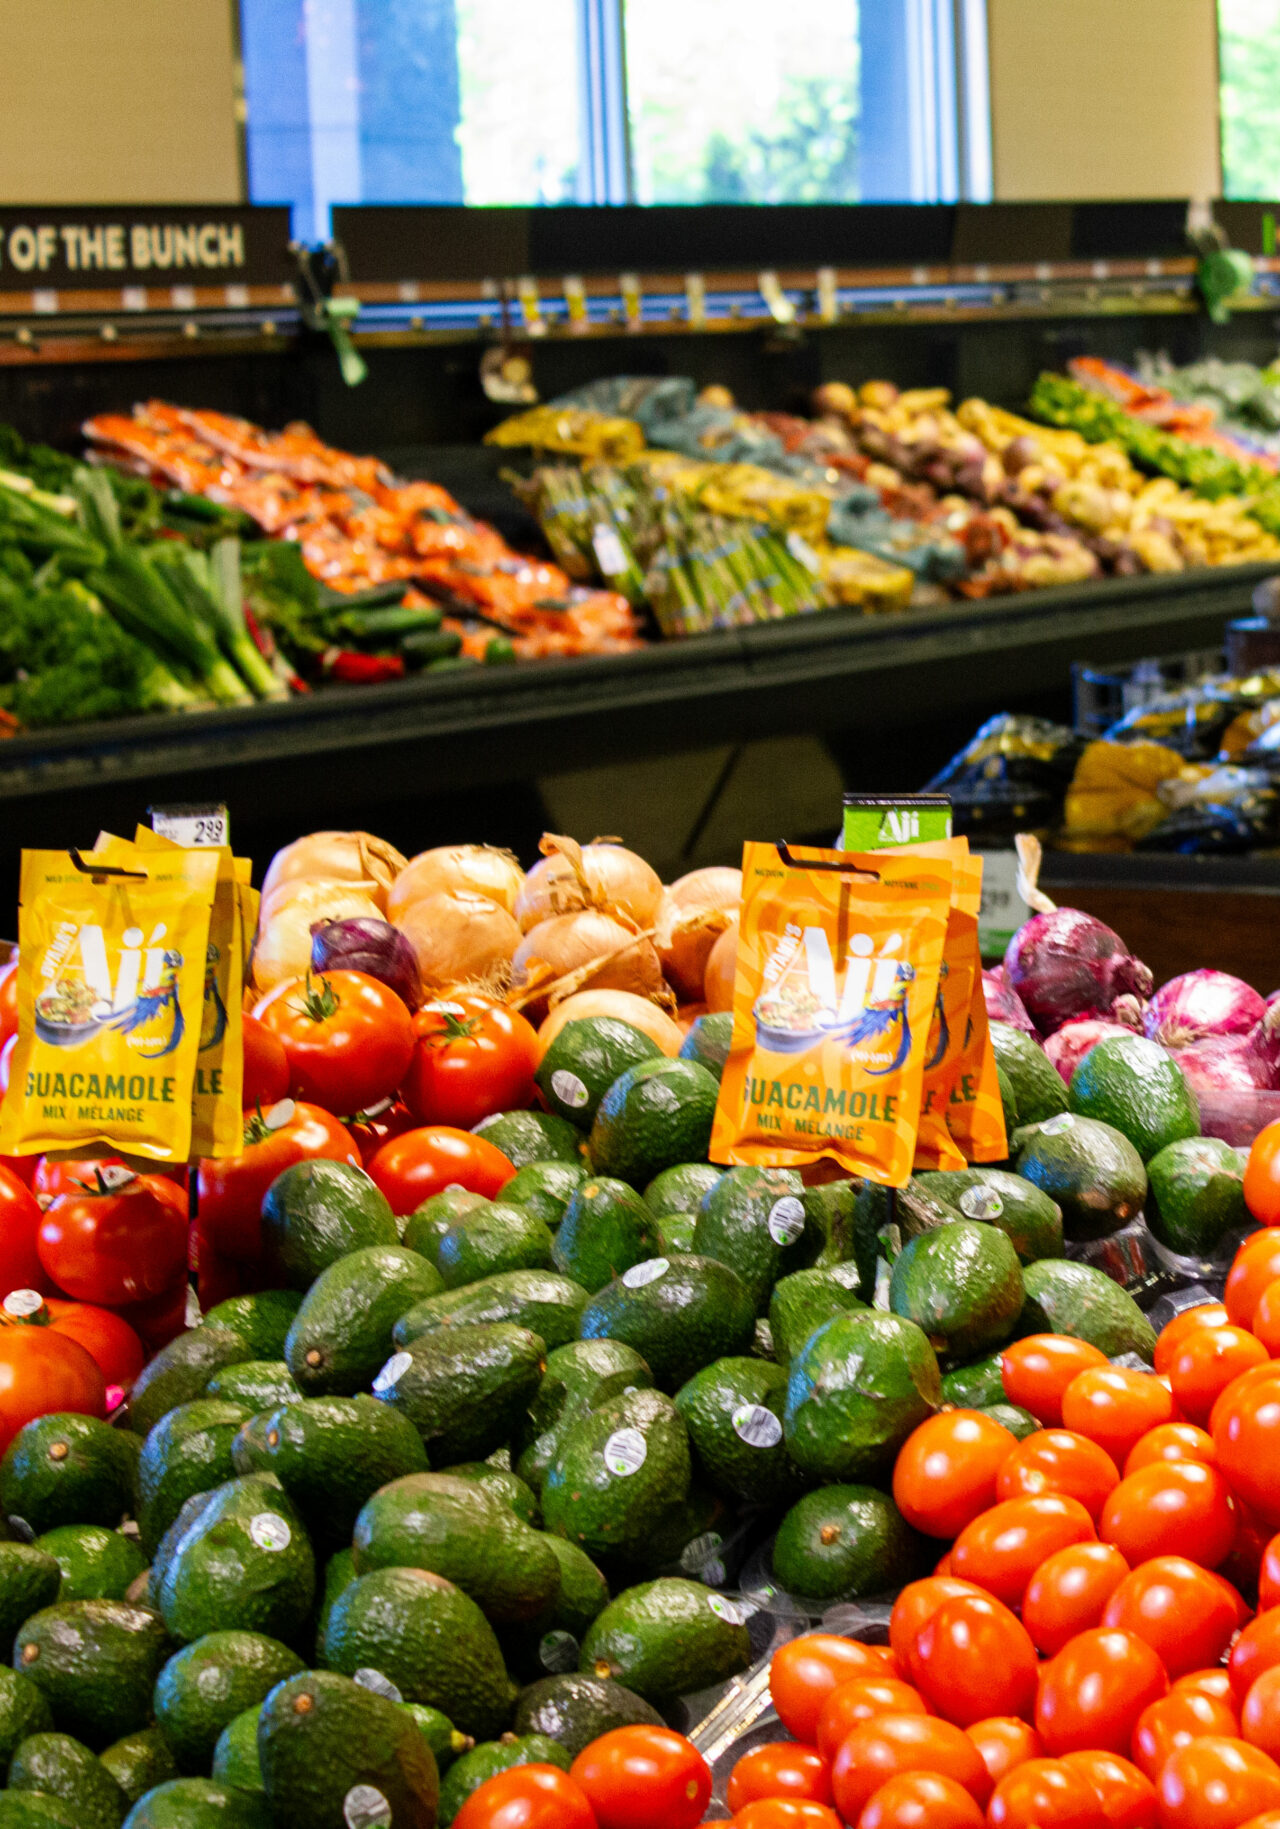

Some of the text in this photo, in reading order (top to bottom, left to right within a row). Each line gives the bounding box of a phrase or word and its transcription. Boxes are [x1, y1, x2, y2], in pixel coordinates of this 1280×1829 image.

[8, 223, 244, 271] OF THE BUNCH
[42, 1105, 66, 1120] MIX
[756, 1112, 782, 1131] MIX
